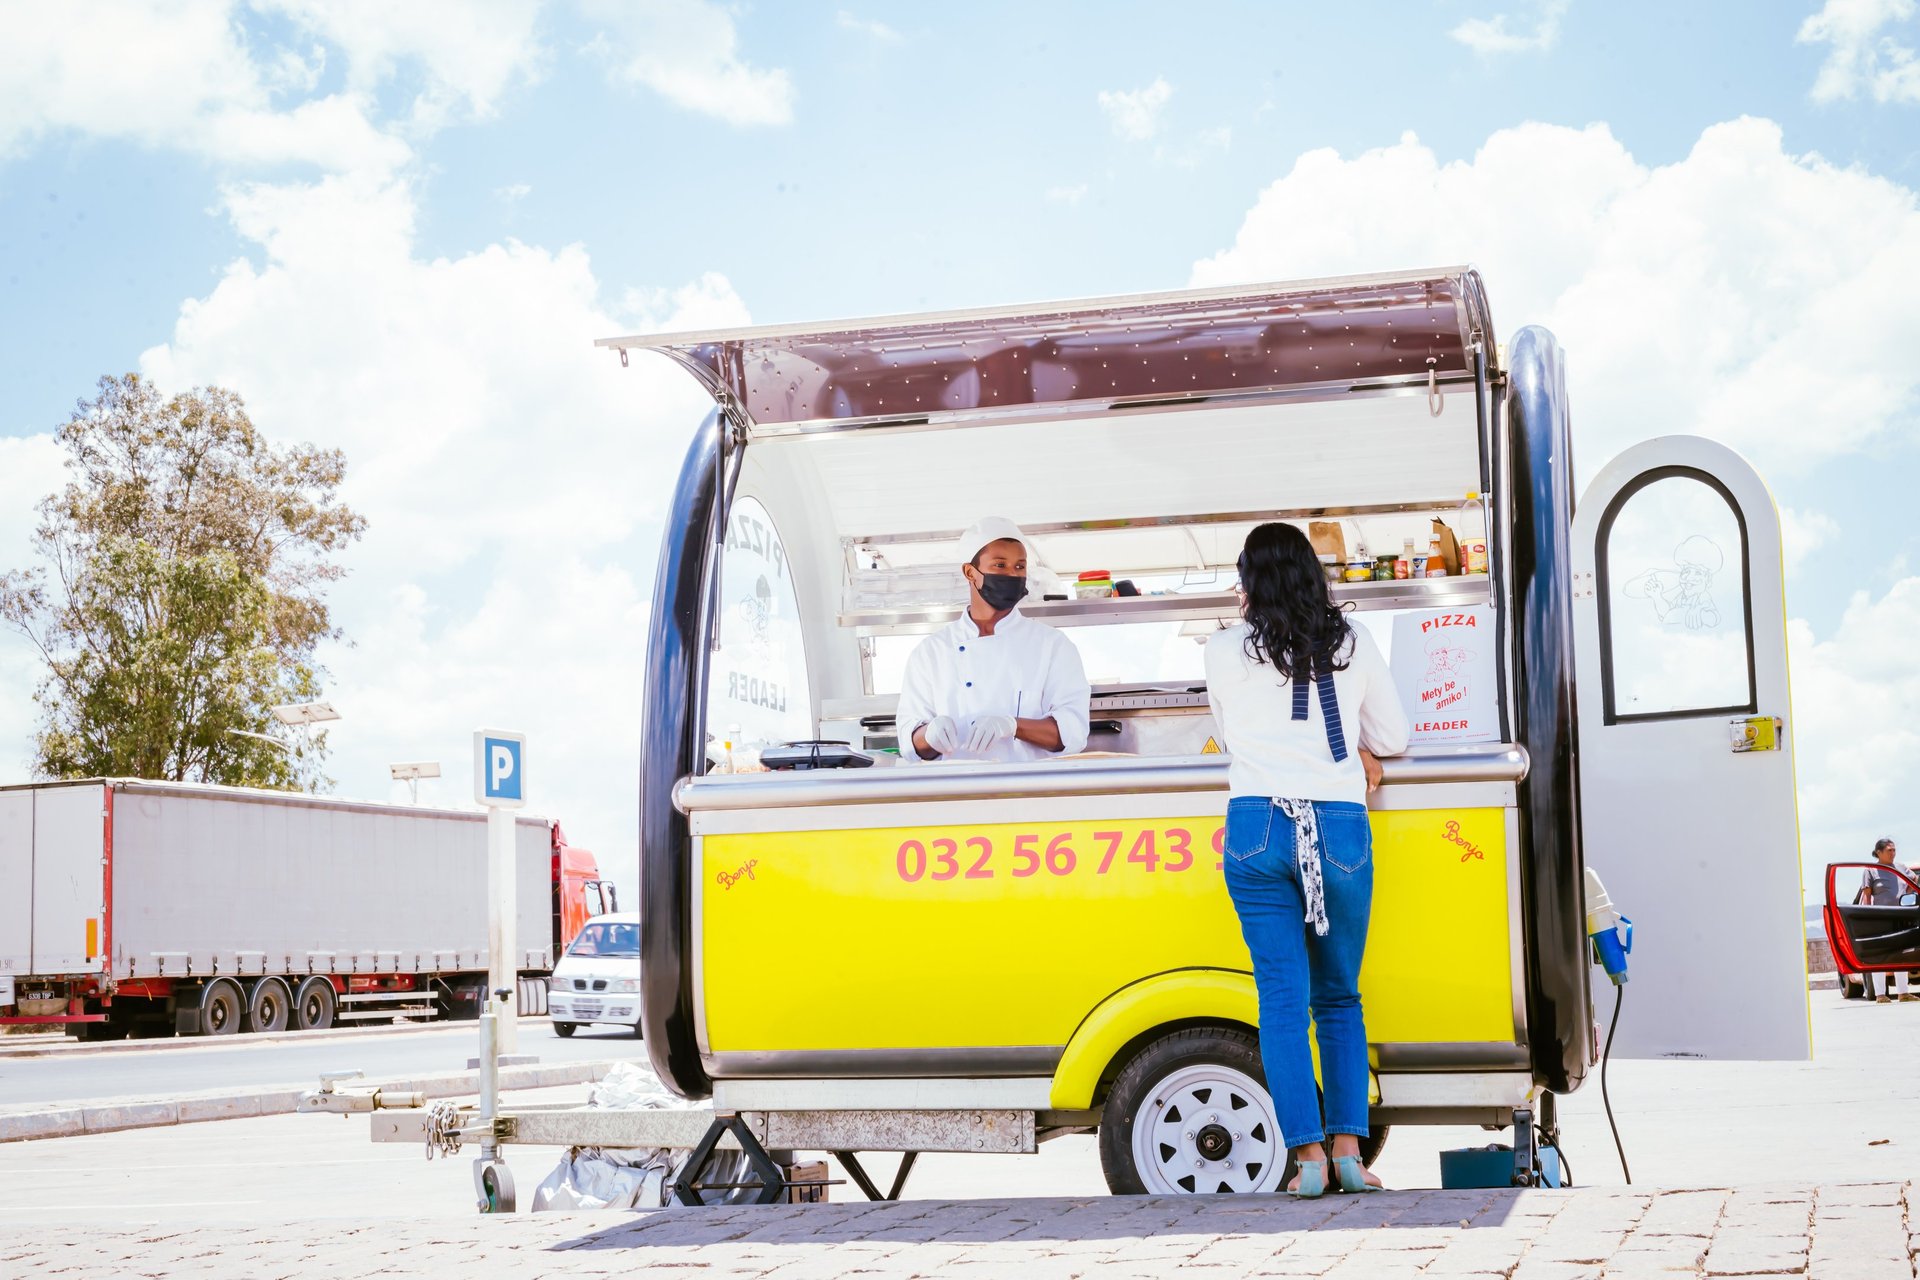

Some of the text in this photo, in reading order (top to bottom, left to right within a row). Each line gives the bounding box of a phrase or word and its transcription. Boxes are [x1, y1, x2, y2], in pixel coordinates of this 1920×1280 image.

[1421, 614, 1476, 634] PIZZA
[1421, 680, 1456, 703] Mety be
[1435, 690, 1462, 711] amiko
[1415, 720, 1469, 732] LEADER
[491, 745, 514, 791] P
[896, 836, 993, 882] 032
[1012, 833, 1077, 878] 56
[1093, 828, 1194, 874] 743
